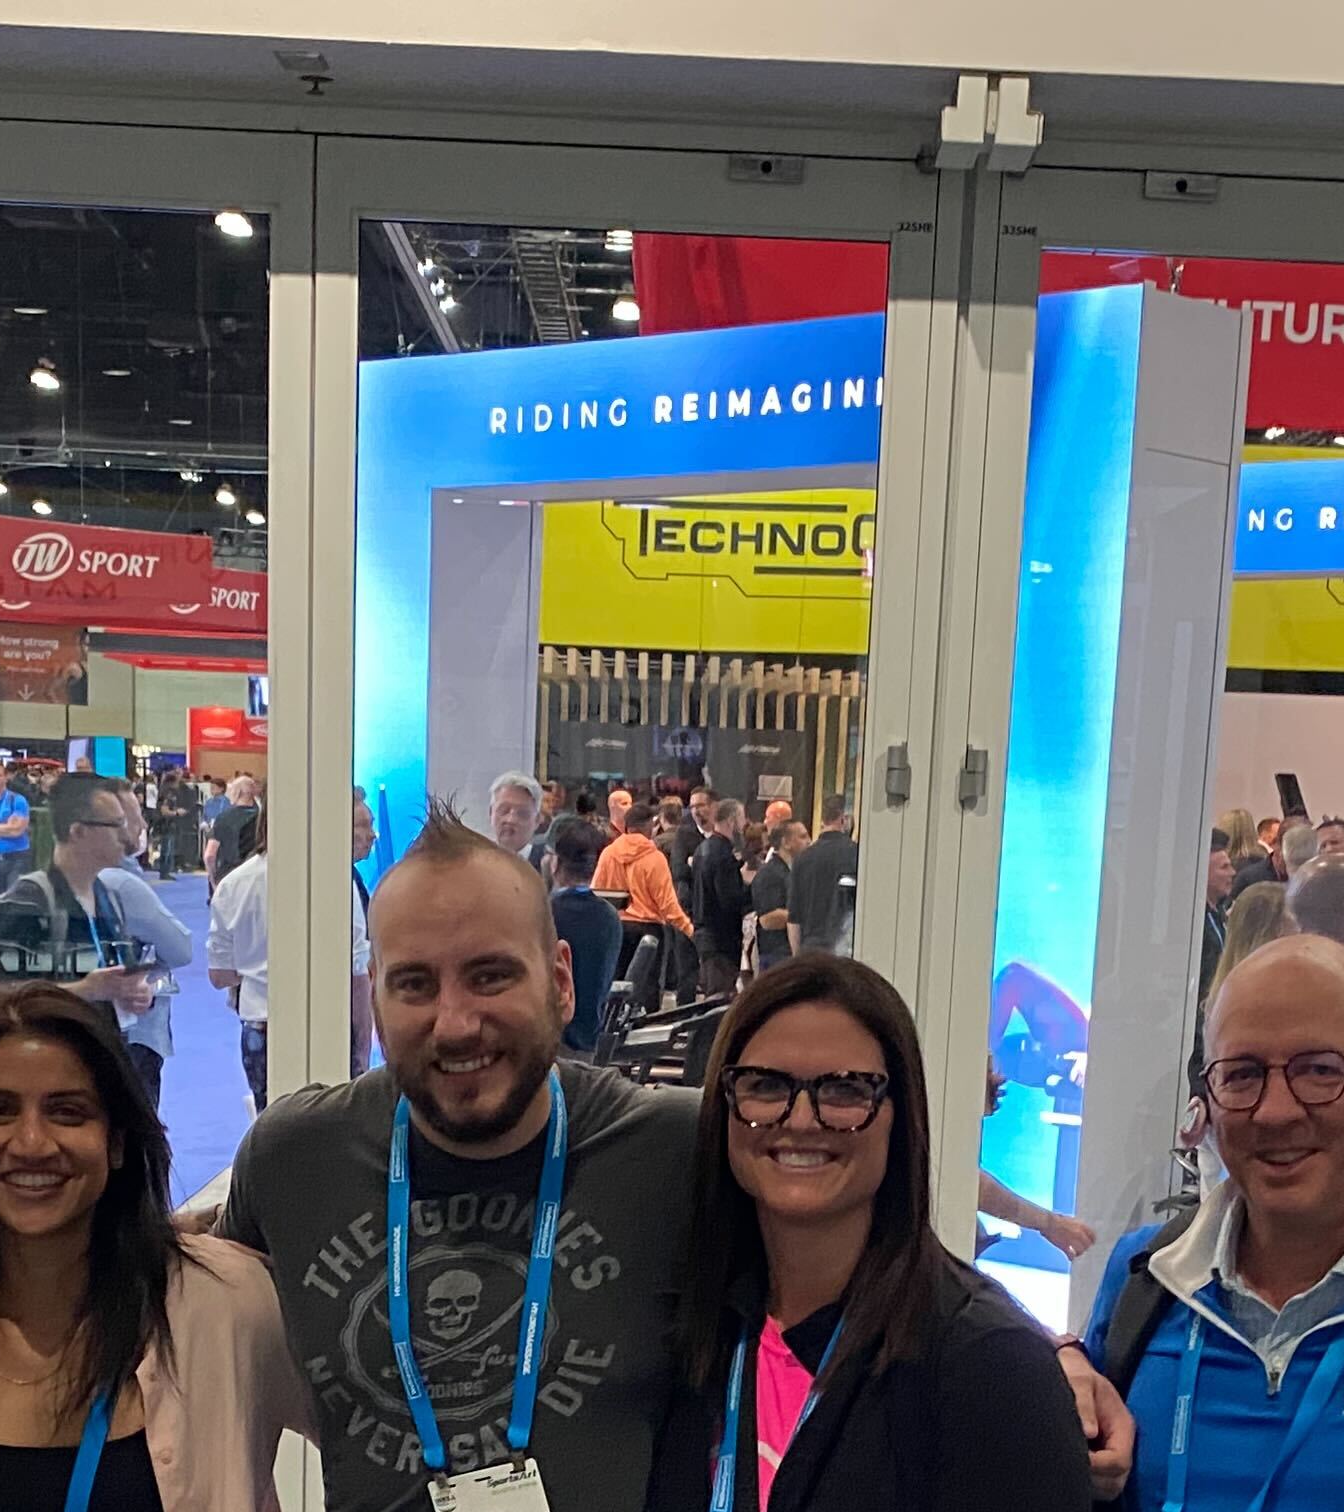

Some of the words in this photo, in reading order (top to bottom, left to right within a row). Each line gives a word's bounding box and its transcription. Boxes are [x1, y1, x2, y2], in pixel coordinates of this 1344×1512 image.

[489, 397, 630, 434] RIDING
[653, 376, 885, 423] REIMAGIN
[77, 549, 160, 578] SPORT
[208, 587, 260, 612] SPORT
[3, 649, 23, 660] are
[24, 648, 52, 662] you?
[22, 637, 59, 651] strong
[302, 1210, 389, 1299] THE
[537, 1339, 615, 1418] DIE
